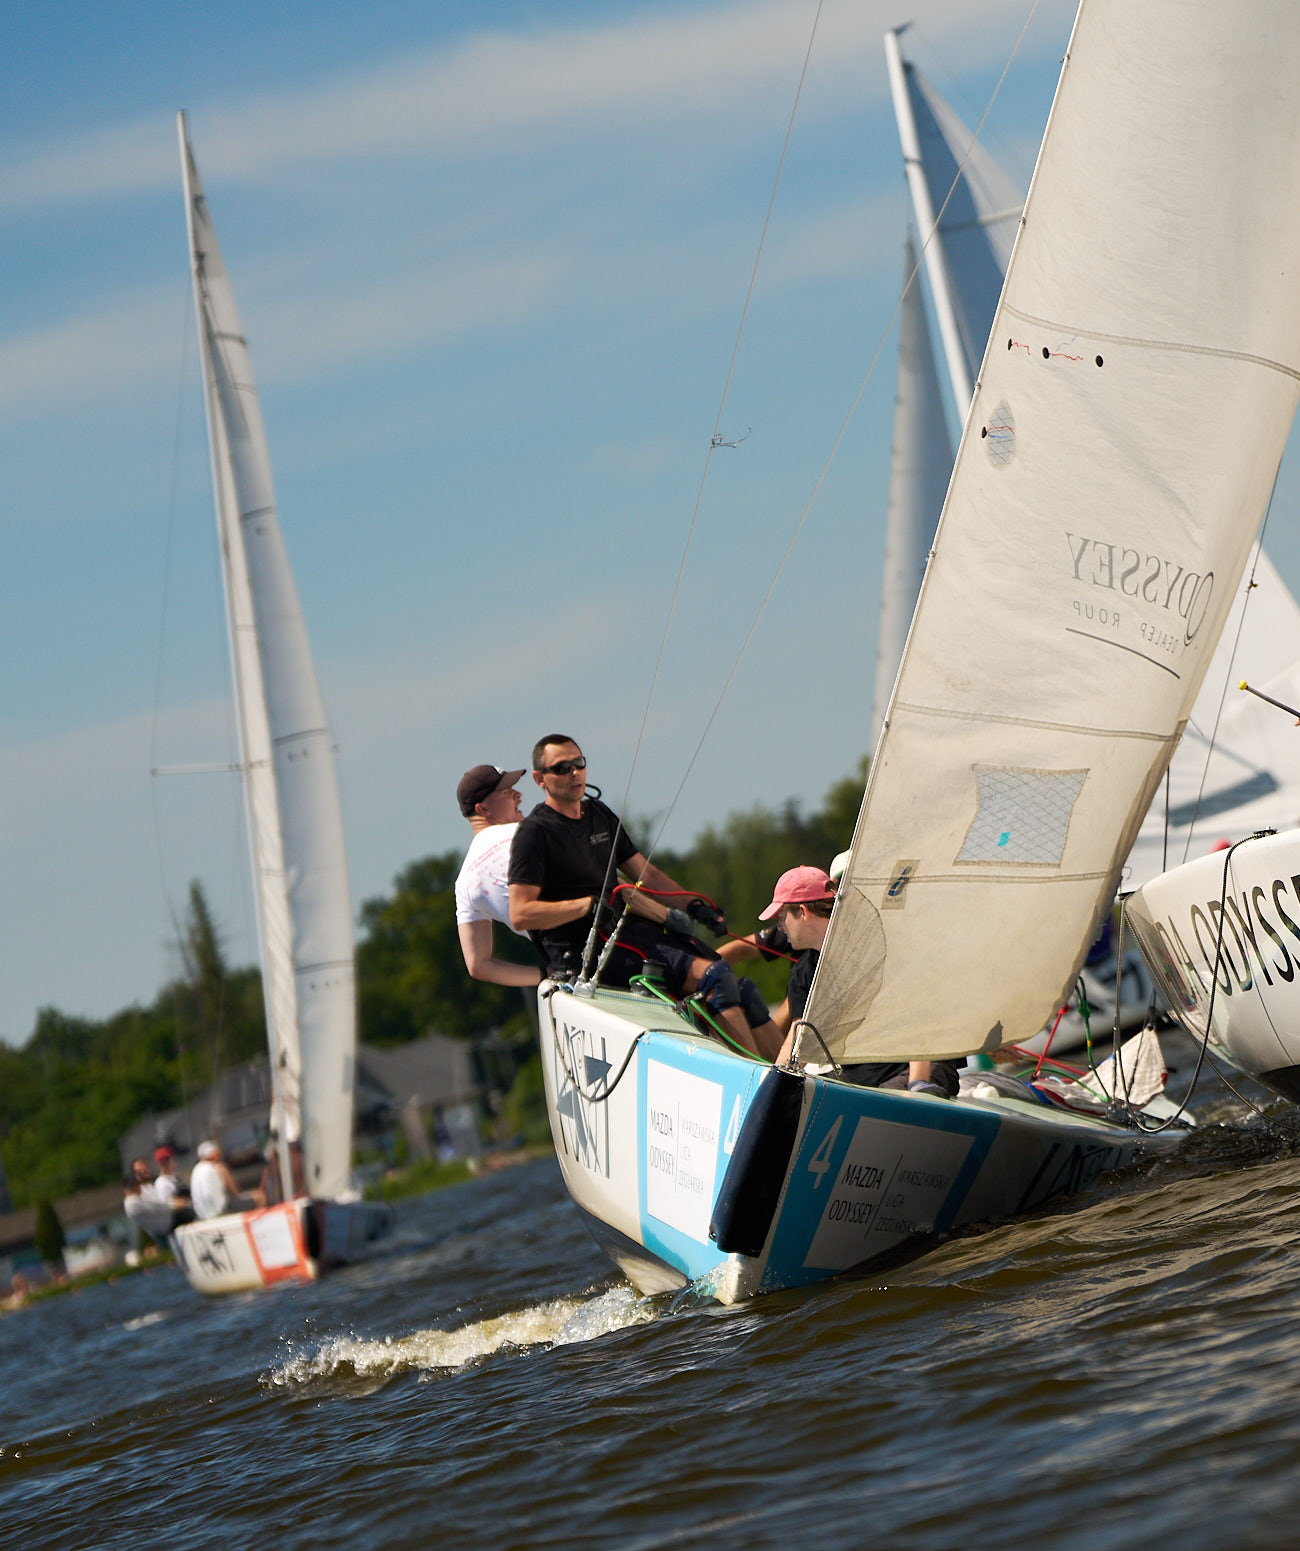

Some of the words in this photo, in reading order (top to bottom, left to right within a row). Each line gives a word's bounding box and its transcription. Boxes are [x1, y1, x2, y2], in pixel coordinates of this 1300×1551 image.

[650, 1106, 674, 1141] MAZDA
[648, 1144, 674, 1176] ODYSSEY
[807, 1113, 845, 1190] 4
[841, 1164, 885, 1191] MAZDA
[827, 1199, 876, 1225] ODYSSEY
